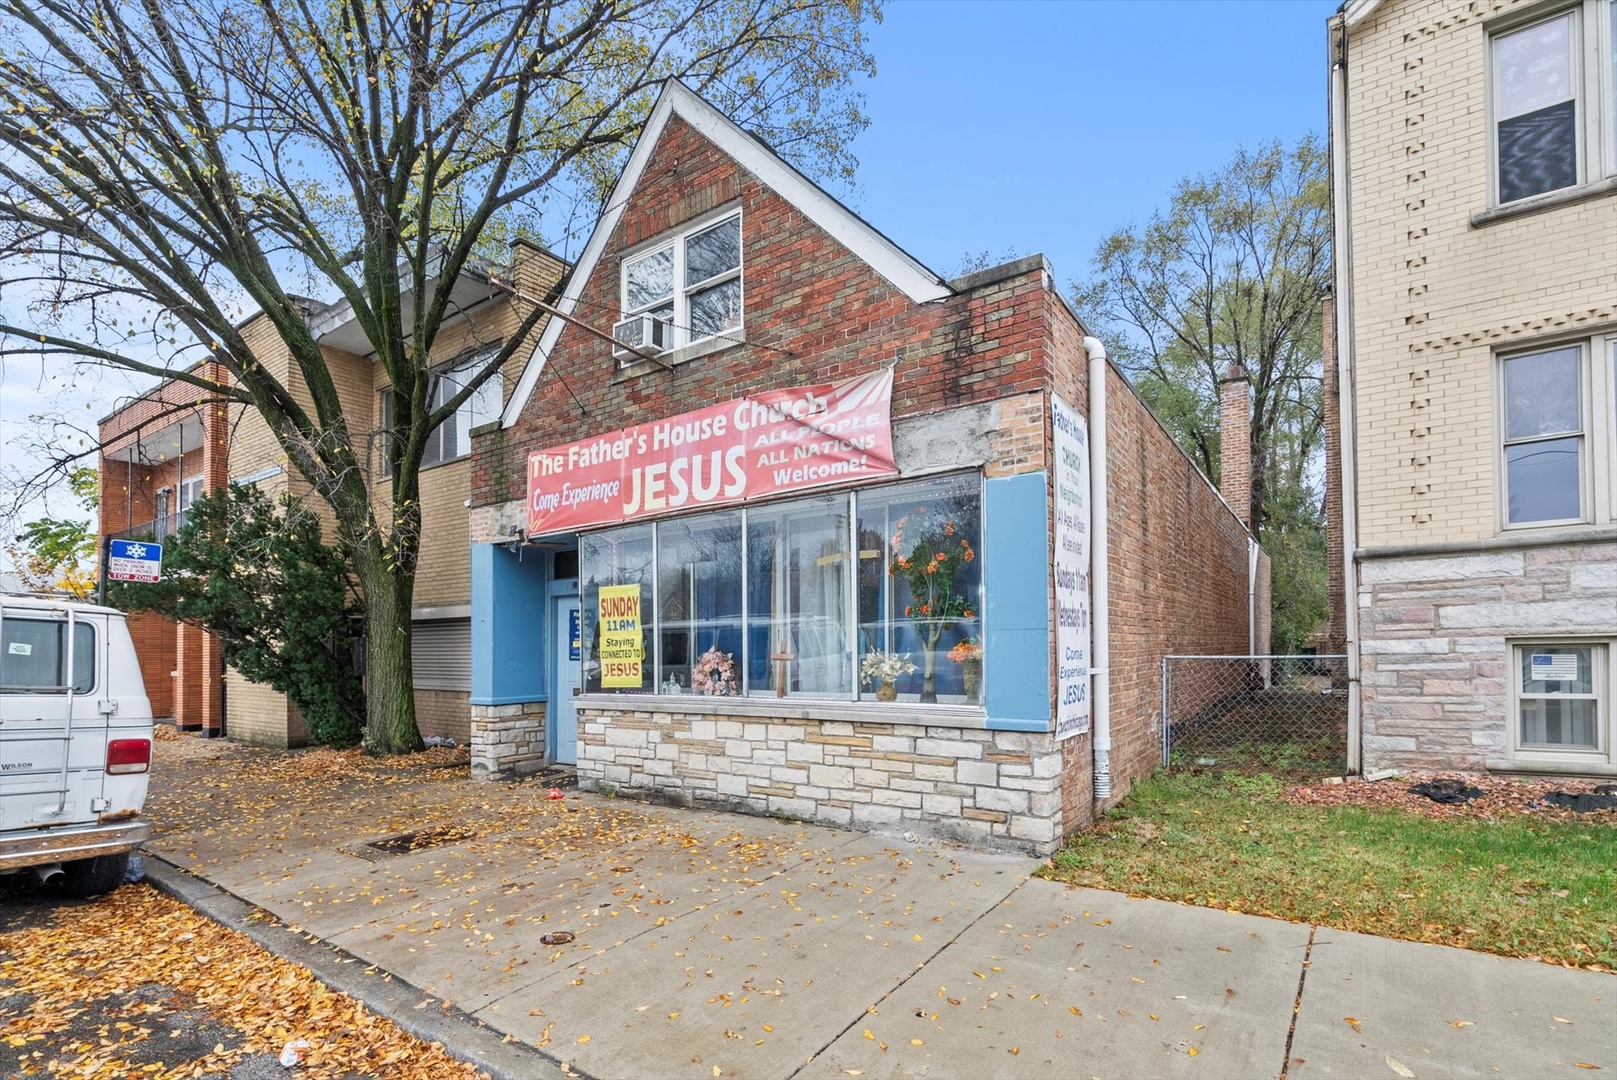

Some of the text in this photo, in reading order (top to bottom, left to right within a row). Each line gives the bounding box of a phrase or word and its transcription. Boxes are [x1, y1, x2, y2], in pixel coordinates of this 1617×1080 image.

[531, 392, 828, 478] The Father's House Church
[754, 413, 881, 447] ALL PEOPLE
[757, 434, 876, 468] ALL NATIONS
[623, 445, 747, 515] JESUS
[773, 455, 867, 486] Welcome!
[533, 479, 620, 513] Come Experience
[601, 596, 639, 618] SUNDAY
[606, 619, 635, 632] 11AM
[606, 637, 635, 648] Staying
[601, 649, 640, 660] CONNECTED TO
[1066, 647, 1083, 661] Come
[604, 662, 639, 677] JESUS
[1060, 666, 1087, 681] Experience
[1063, 683, 1085, 706] JESUS
[1, 762, 33, 770] WILSON
